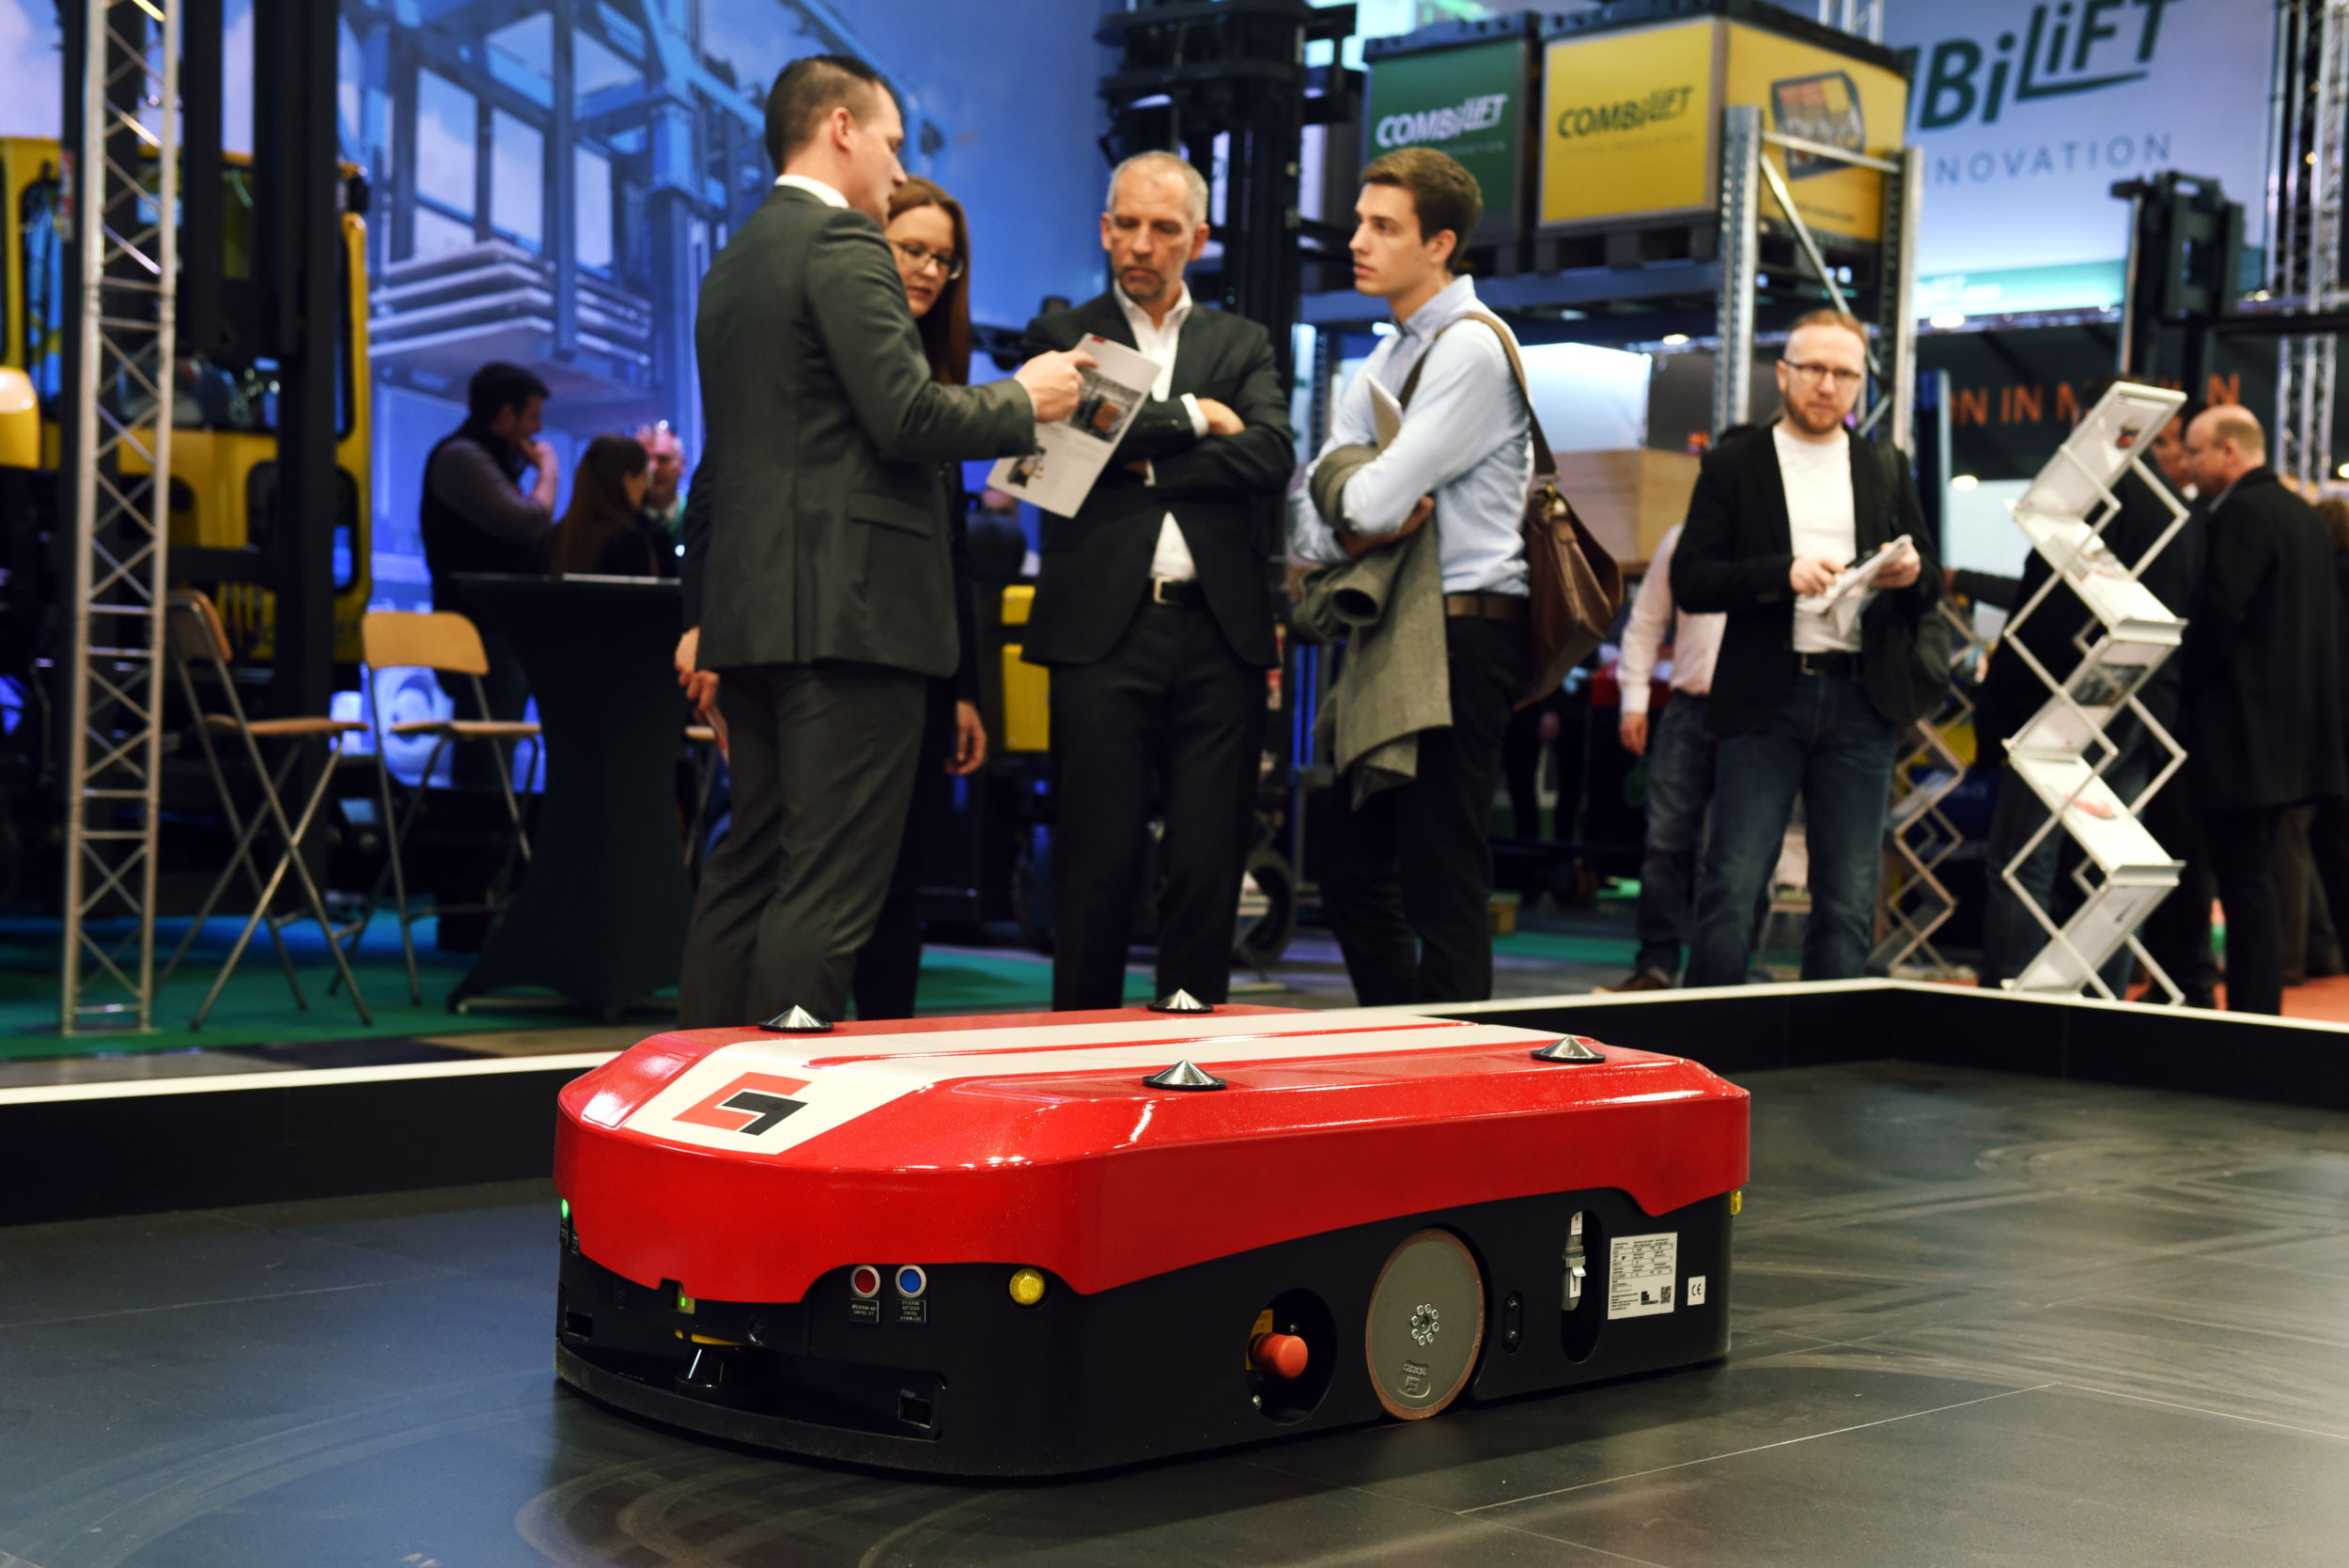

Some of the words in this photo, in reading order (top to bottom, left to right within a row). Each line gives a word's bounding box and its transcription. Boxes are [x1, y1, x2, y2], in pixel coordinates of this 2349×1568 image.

[1936, 132, 2171, 183] NOVATION
[2001, 385, 2043, 423] IN
[1691, 1283, 1702, 1296] CE
